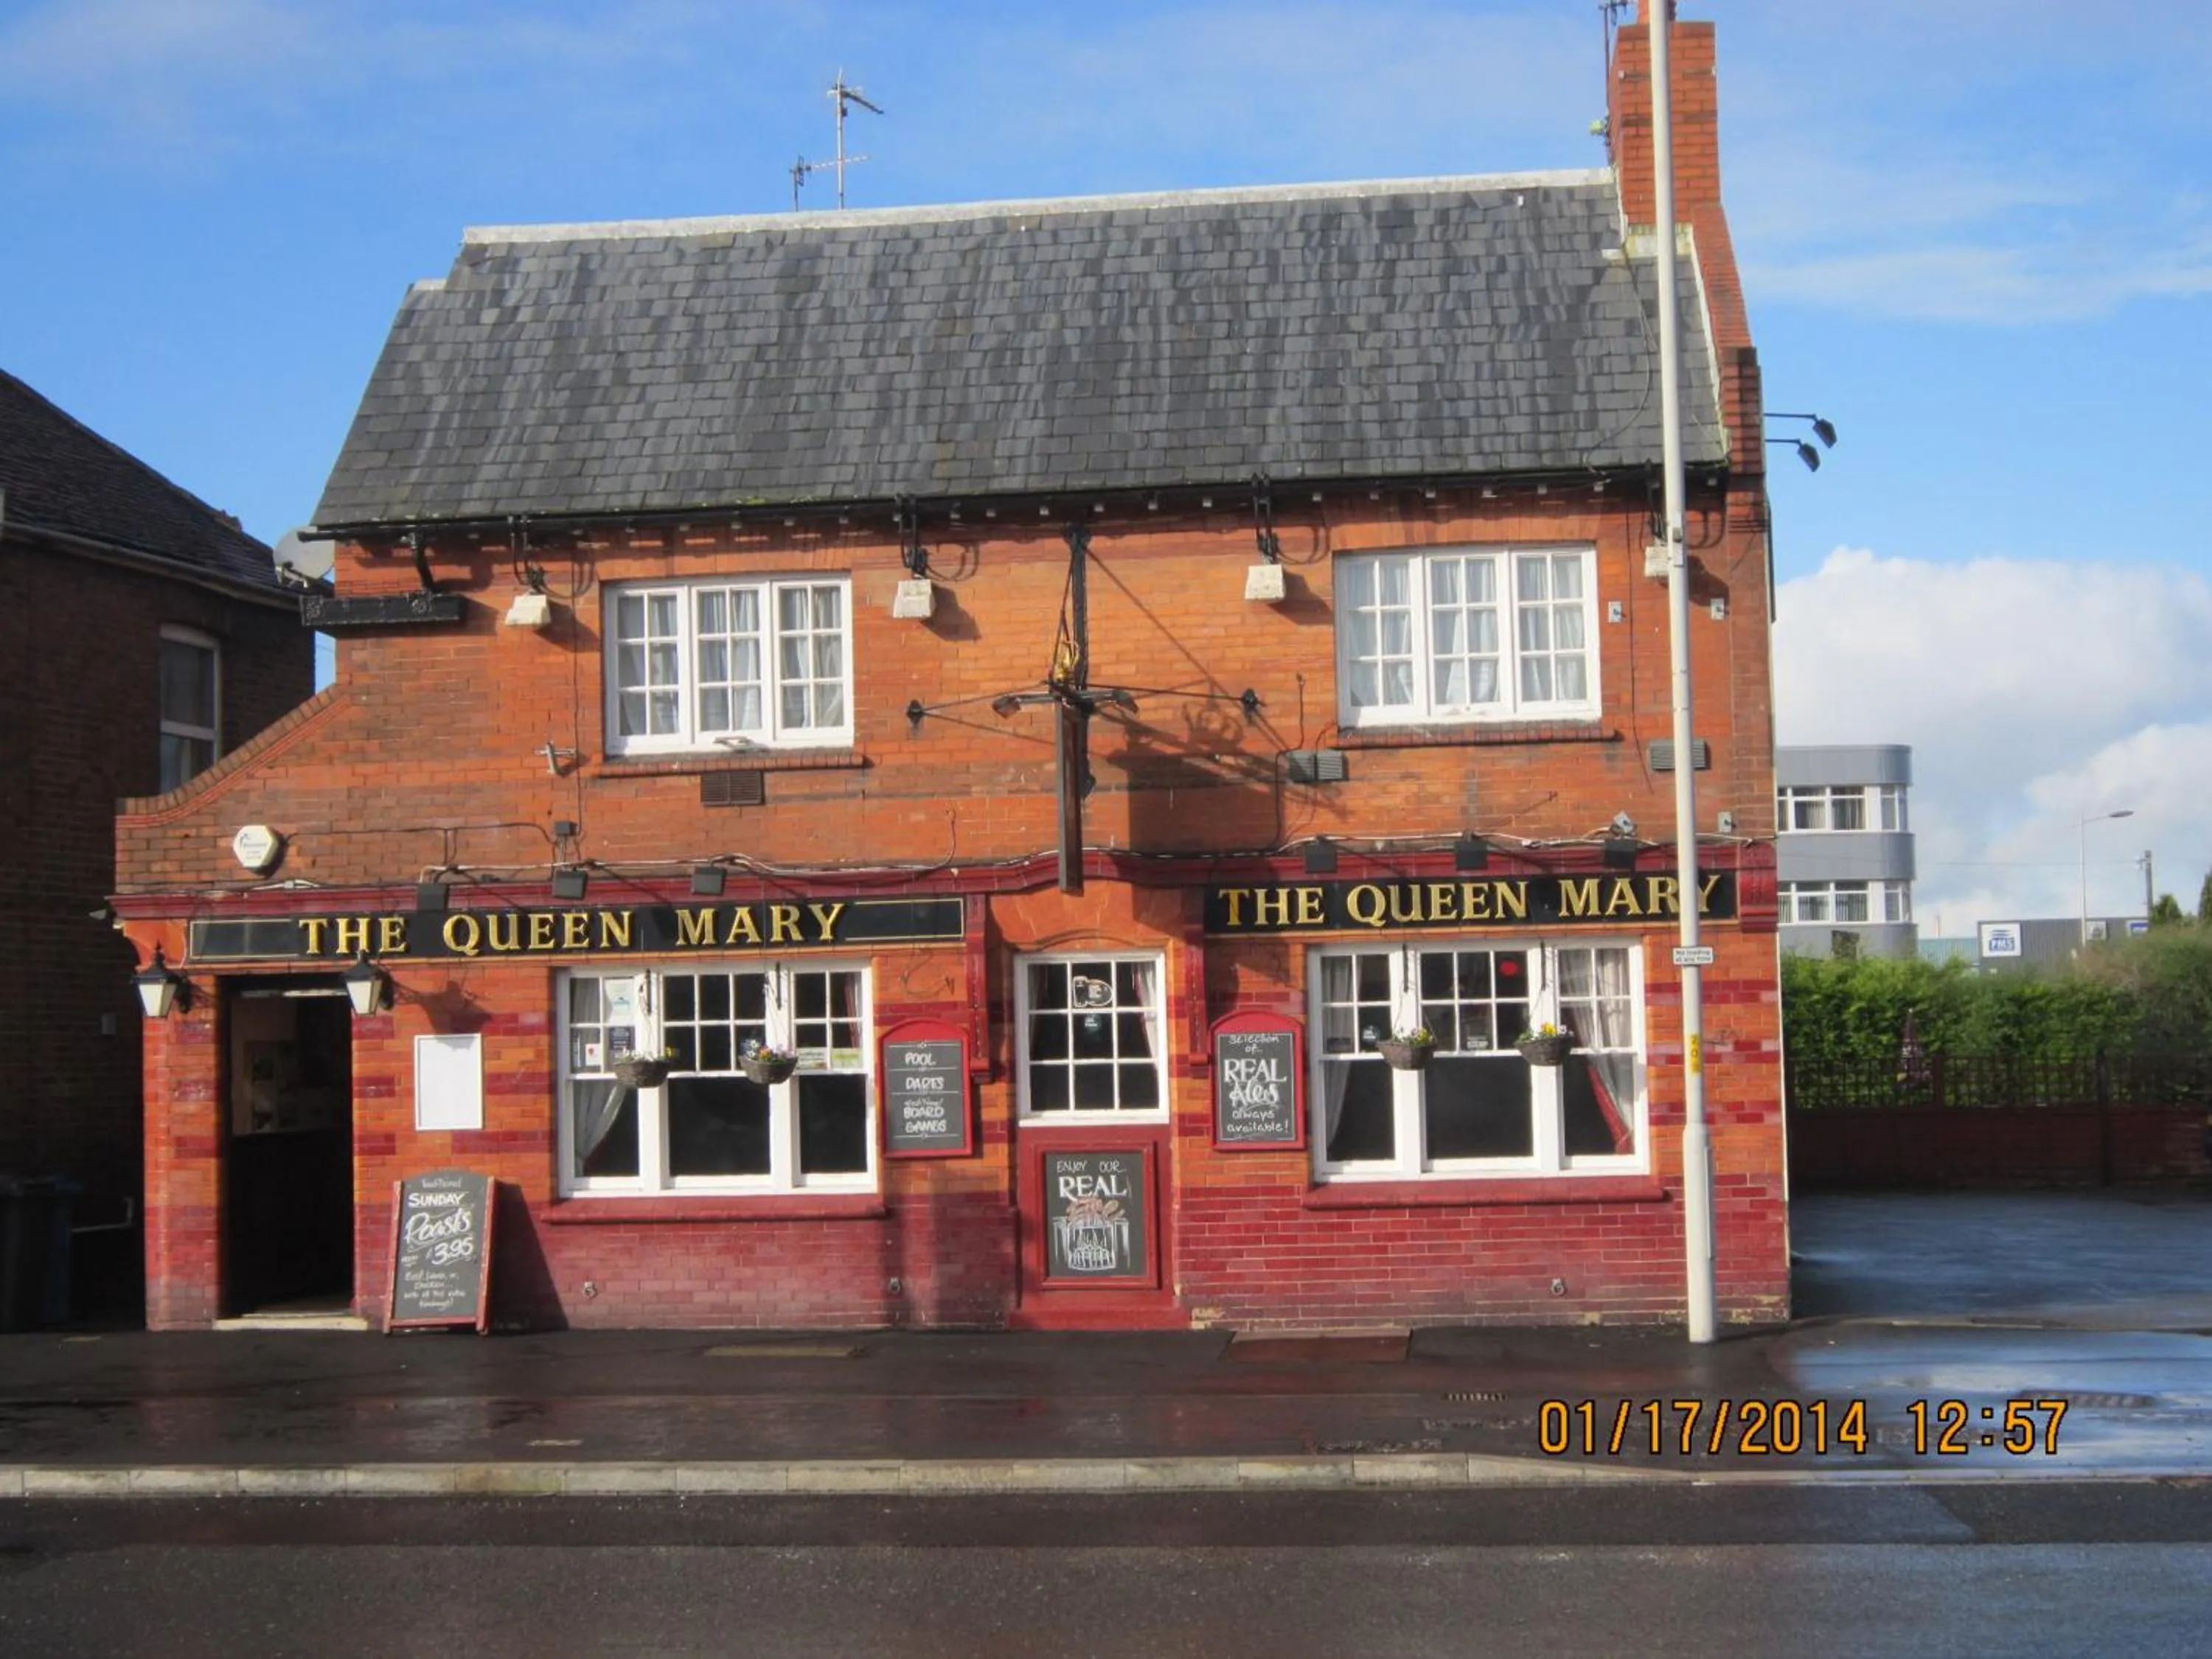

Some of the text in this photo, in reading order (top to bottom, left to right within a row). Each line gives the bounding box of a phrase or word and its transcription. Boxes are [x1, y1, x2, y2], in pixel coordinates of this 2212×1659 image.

[1220, 874, 1721, 927] THE QUEEN MARY
[298, 902, 845, 957] THE QUEEN MARY
[1224, 1058, 1287, 1082] REAL
[906, 1077, 945, 1090] DARTS
[903, 1107, 945, 1119] BOARD
[1233, 1107, 1275, 1121] always
[905, 1120, 947, 1133] GAMES
[1057, 1160, 1088, 1174] ENJOY
[1059, 1175, 1128, 1204] REAL
[408, 1192, 469, 1207] SUNDAY
[405, 1208, 472, 1245] Roasts
